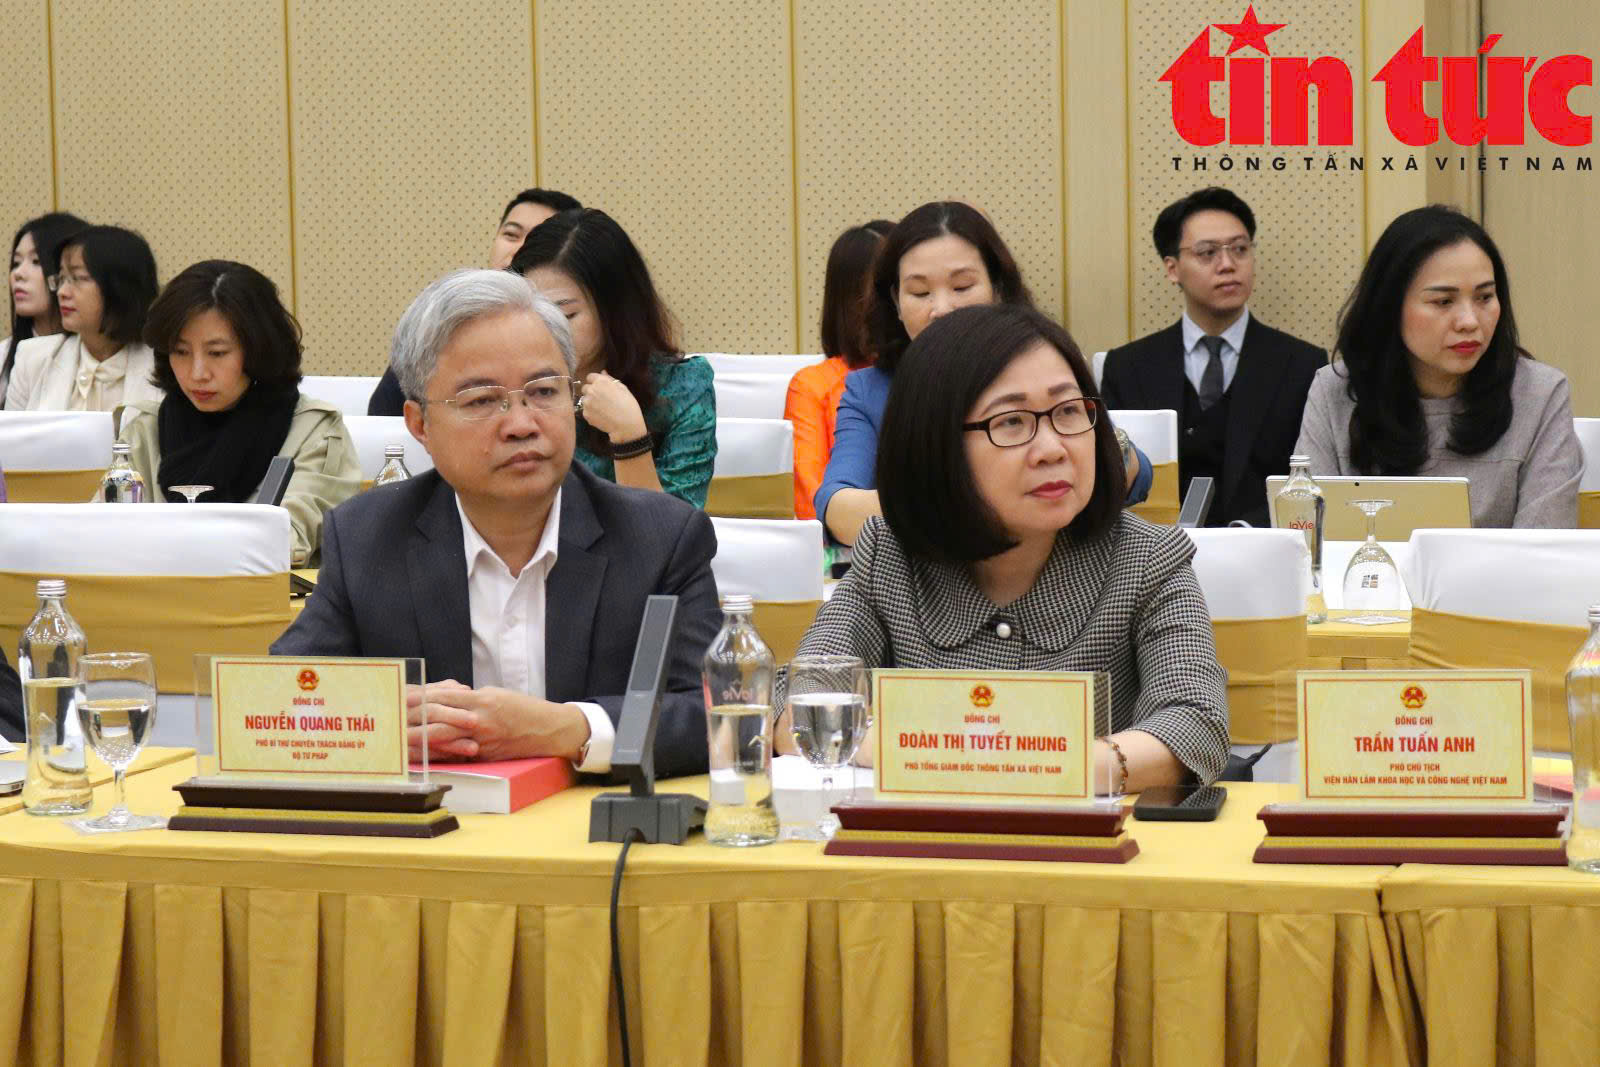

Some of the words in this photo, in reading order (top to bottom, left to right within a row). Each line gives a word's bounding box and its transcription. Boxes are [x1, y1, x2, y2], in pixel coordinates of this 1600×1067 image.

[245, 710, 296, 731] NGUYỄN
[299, 716, 343, 732] QUANG
[346, 713, 375, 732] THÁI
[899, 730, 939, 749] ĐOÀN
[943, 733, 965, 753] THỊ
[969, 730, 1012, 751] TUYẾT
[1016, 735, 1067, 752] NHUNG
[1398, 731, 1439, 753] TUẤN
[1443, 736, 1475, 753] ANH
[1044, 765, 1062, 774] NAM
[1377, 776, 1398, 784] KHOA
[1489, 776, 1508, 785] NAM
